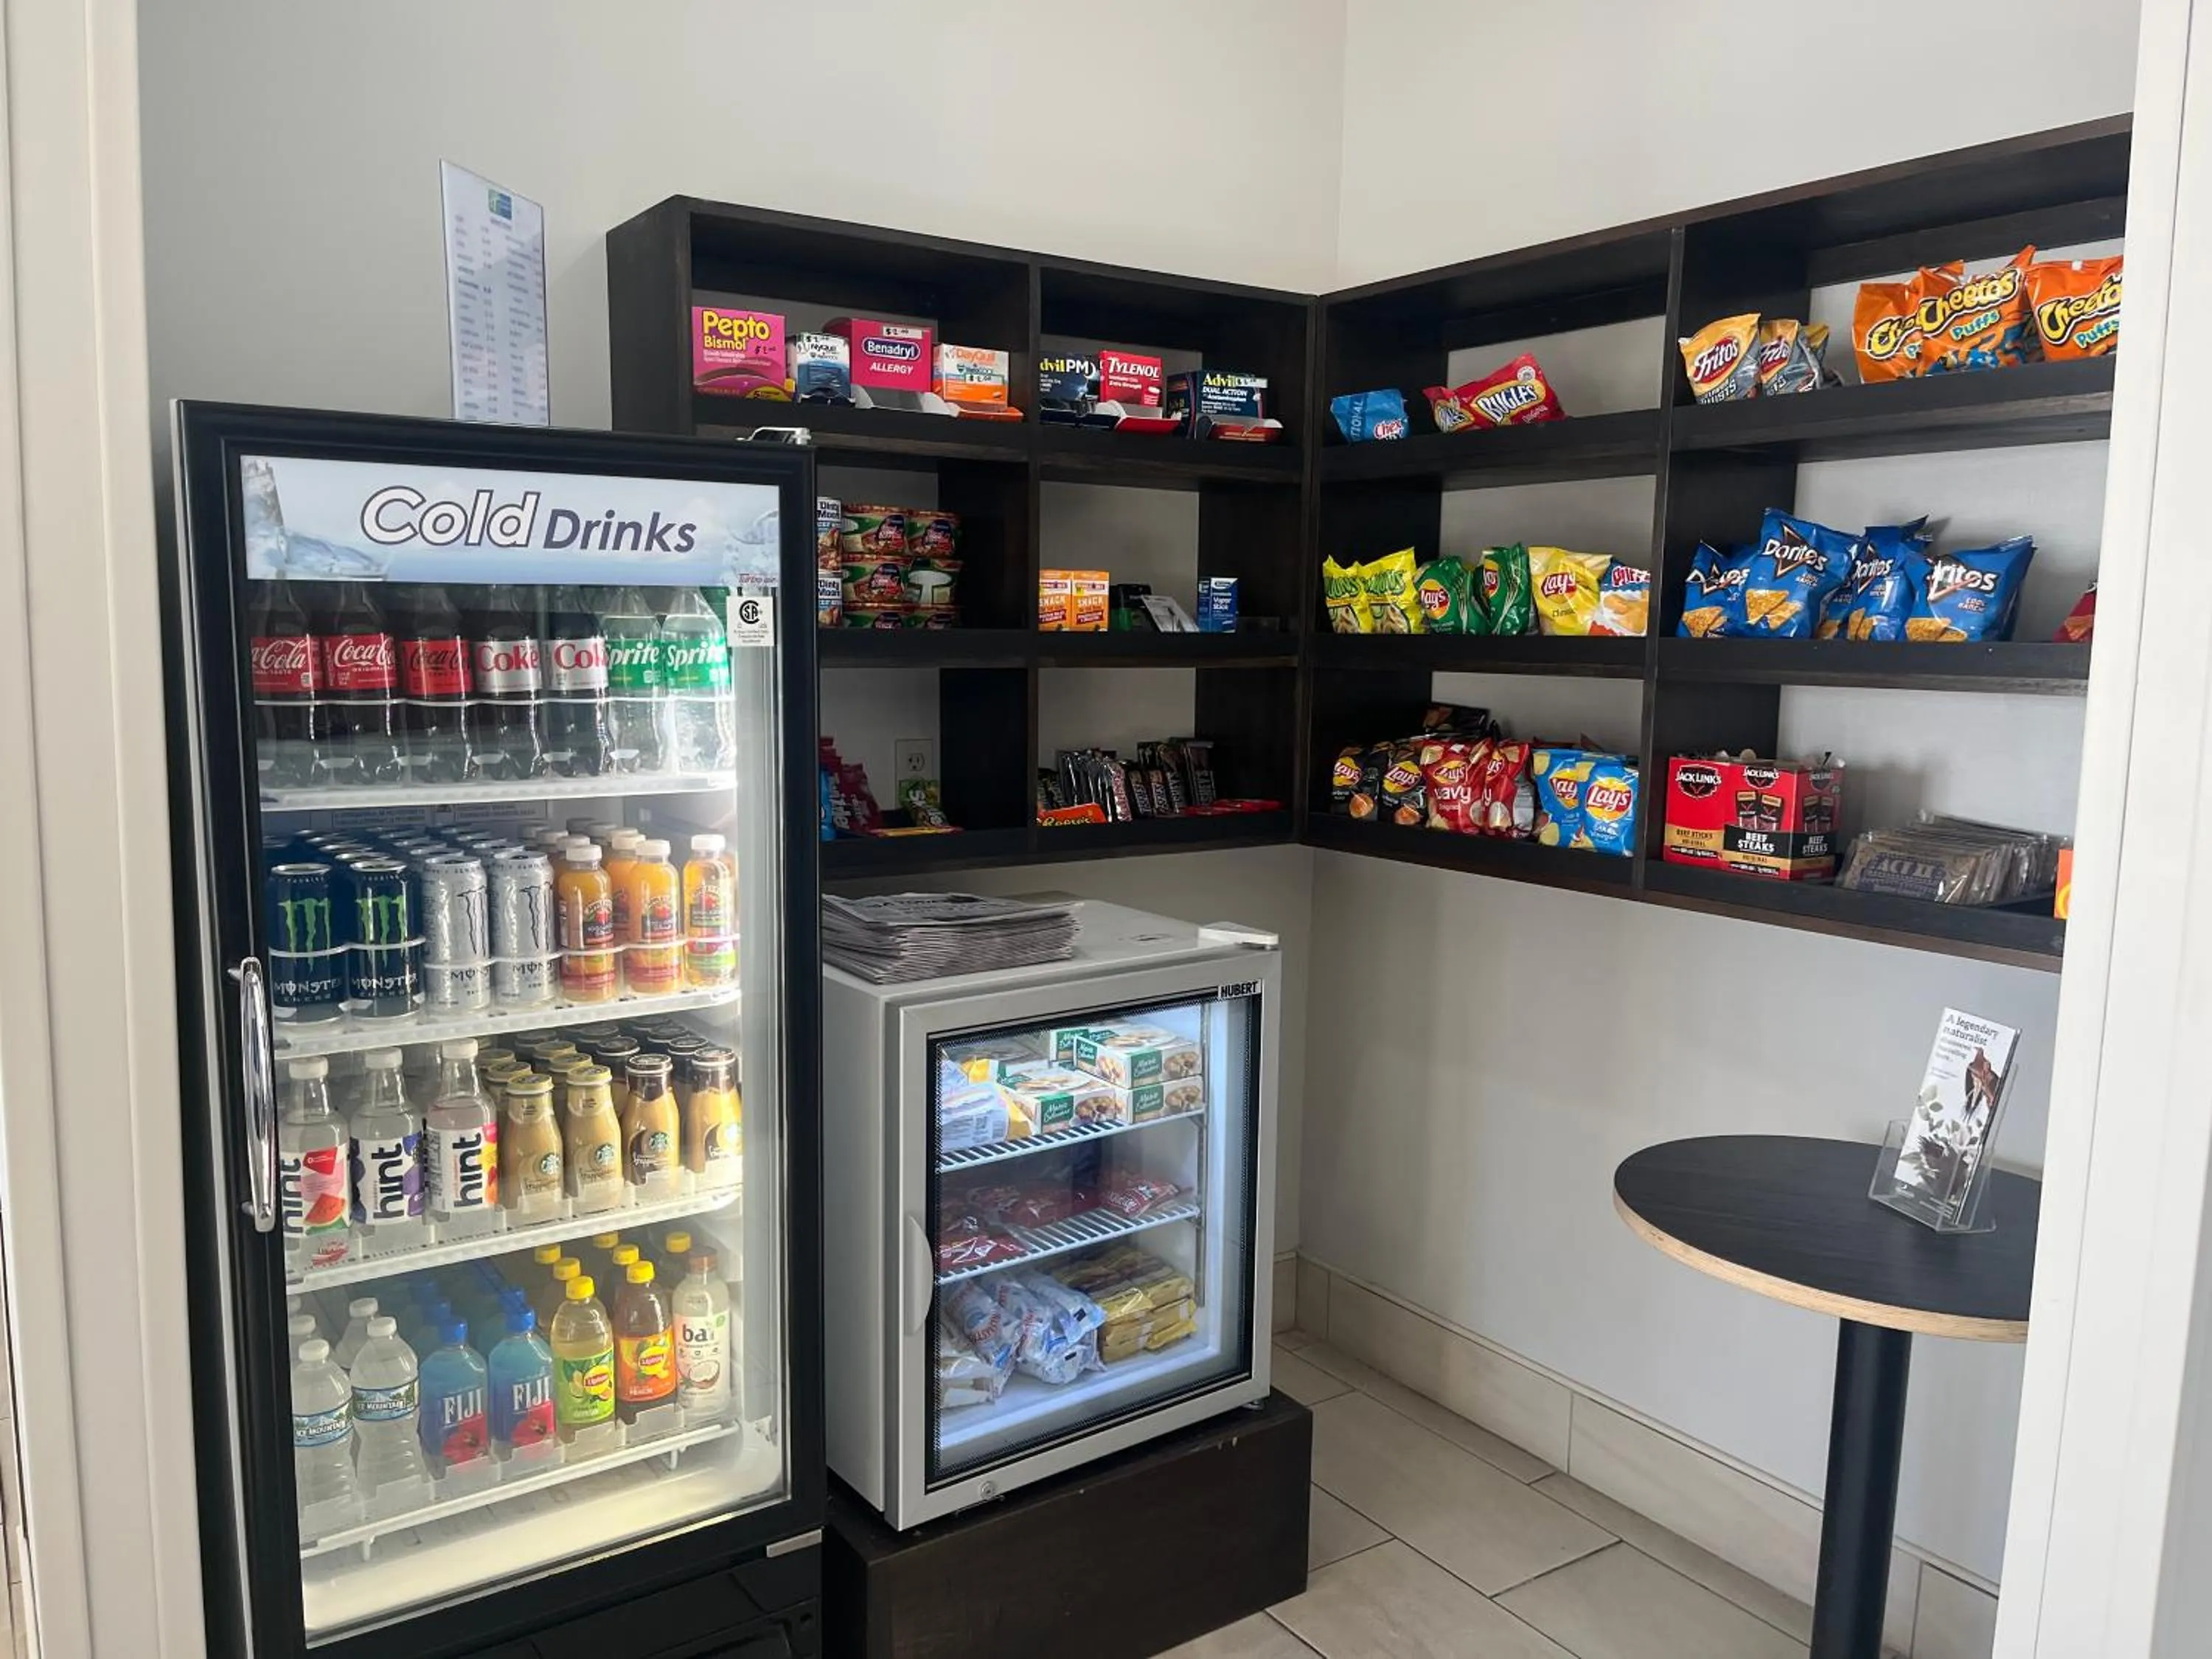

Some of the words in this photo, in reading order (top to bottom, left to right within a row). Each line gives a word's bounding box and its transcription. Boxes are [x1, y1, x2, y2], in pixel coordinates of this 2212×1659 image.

[1919, 270, 2020, 330] Cheetos
[2039, 277, 2123, 339] Cheeto
[703, 310, 770, 341] Pepto
[1952, 310, 2000, 340] Puffs
[703, 335, 745, 350] Bismol
[868, 341, 915, 358] Benadryl
[870, 362, 914, 374] ALLERGY
[1039, 358, 1065, 372] dvil
[1066, 359, 1089, 375] PM
[1107, 357, 1159, 378] TYLENOL
[1694, 339, 1739, 382] Fritos
[1350, 400, 1364, 437] TIONAL
[1477, 385, 1537, 422] BUGLES
[361, 485, 540, 549] Cold
[543, 509, 696, 553] Drinks
[1762, 539, 1828, 571] Doritos
[478, 644, 539, 672] Coke
[1738, 839, 1775, 853] STEAKS
[1745, 832, 1768, 842] BEEF
[1220, 981, 1258, 998] HUBERT
[1943, 1026, 1989, 1046] naturalist
[1955, 1015, 1999, 1040] legendary
[371, 1143, 405, 1219] hint
[452, 1133, 483, 1208] hint
[682, 1324, 714, 1342] bai
[444, 1388, 482, 1423] FIJI
[514, 1377, 550, 1411] FIJI
